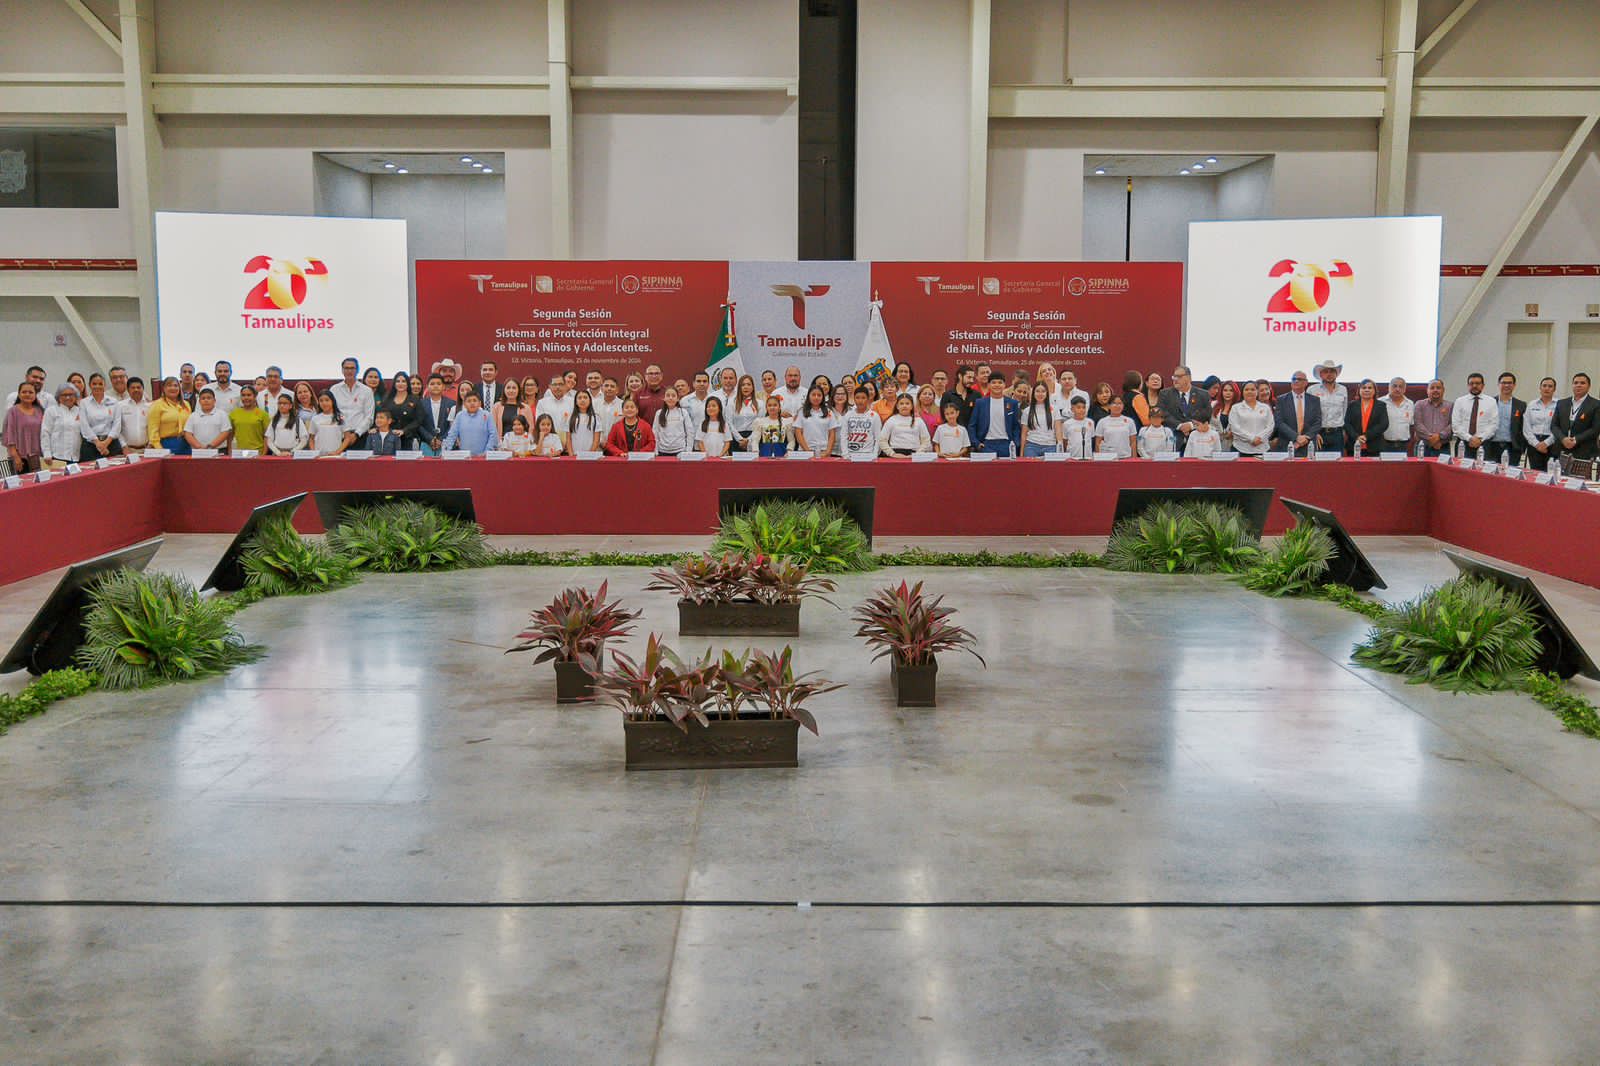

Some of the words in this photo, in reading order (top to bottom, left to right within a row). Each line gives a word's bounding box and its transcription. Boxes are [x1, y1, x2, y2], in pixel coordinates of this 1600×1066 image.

[490, 281, 528, 289] Tamaulipas
[642, 276, 683, 285] SIPINNA
[1088, 278, 1129, 287] SIPINNA
[938, 283, 976, 291] Tamaulipas
[532, 308, 576, 320] Segunda
[578, 308, 612, 318] Sesión
[986, 310, 1030, 322] Segunda
[1032, 310, 1066, 320] Sesión
[241, 312, 334, 332] Tamaulipas
[567, 320, 578, 328] del
[1263, 316, 1356, 336] Tamaulipas
[495, 328, 536, 338] Sistema
[538, 328, 550, 338] de
[553, 328, 608, 338] Protección
[610, 328, 650, 340] Integral
[949, 330, 989, 340] Sistema
[992, 330, 1004, 340] de
[1006, 330, 1060, 340] Protección
[1063, 330, 1104, 342] Integral
[493, 342, 506, 352] de
[508, 342, 540, 354] Niñas,
[542, 342, 572, 352] Niños
[574, 344, 580, 354] y
[583, 342, 652, 352] Adolescentes.
[757, 334, 842, 350] Tamaulipas
[946, 344, 959, 354] de
[961, 344, 993, 355] Niñas,
[996, 344, 1024, 354] Niños
[1026, 346, 1033, 356] y
[1036, 344, 1105, 354] Adolescentes.
